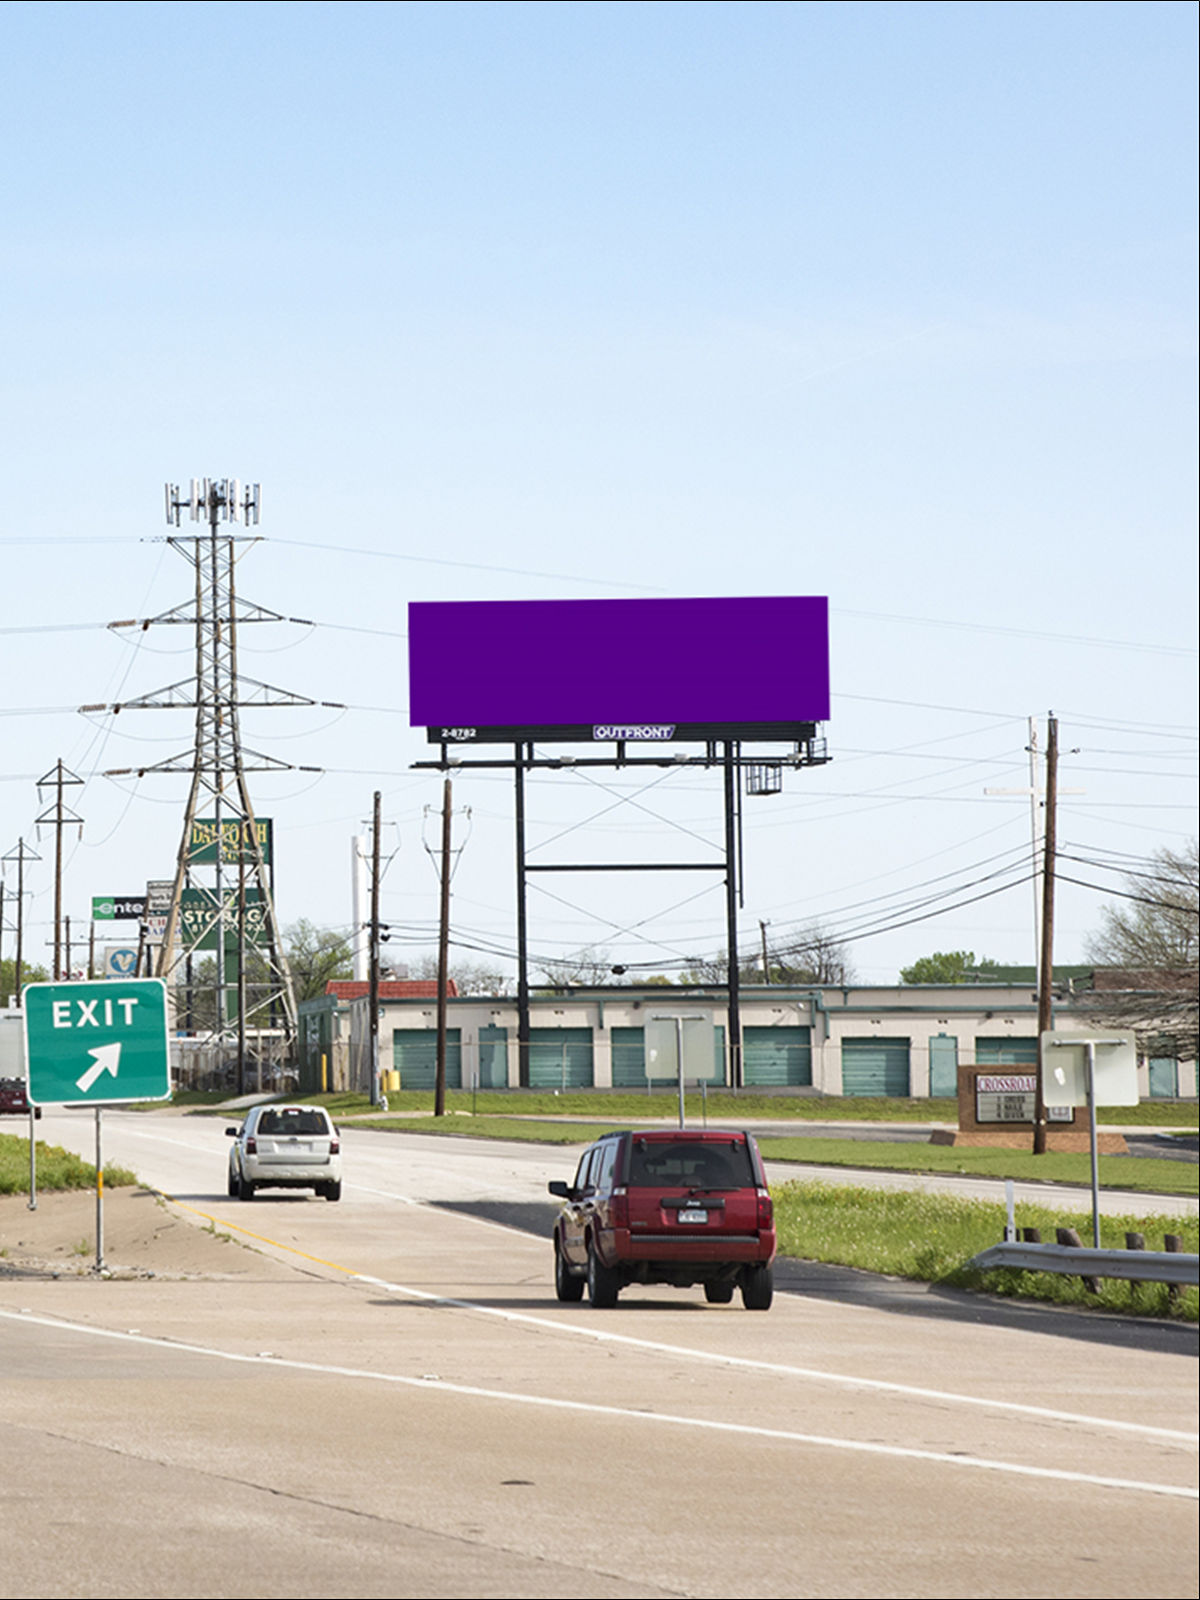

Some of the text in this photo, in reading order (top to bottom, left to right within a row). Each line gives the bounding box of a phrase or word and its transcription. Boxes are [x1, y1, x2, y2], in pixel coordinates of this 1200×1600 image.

[596, 725, 672, 739] OUTFRONT
[93, 902, 146, 915] ente
[52, 998, 139, 1028] EXIT
